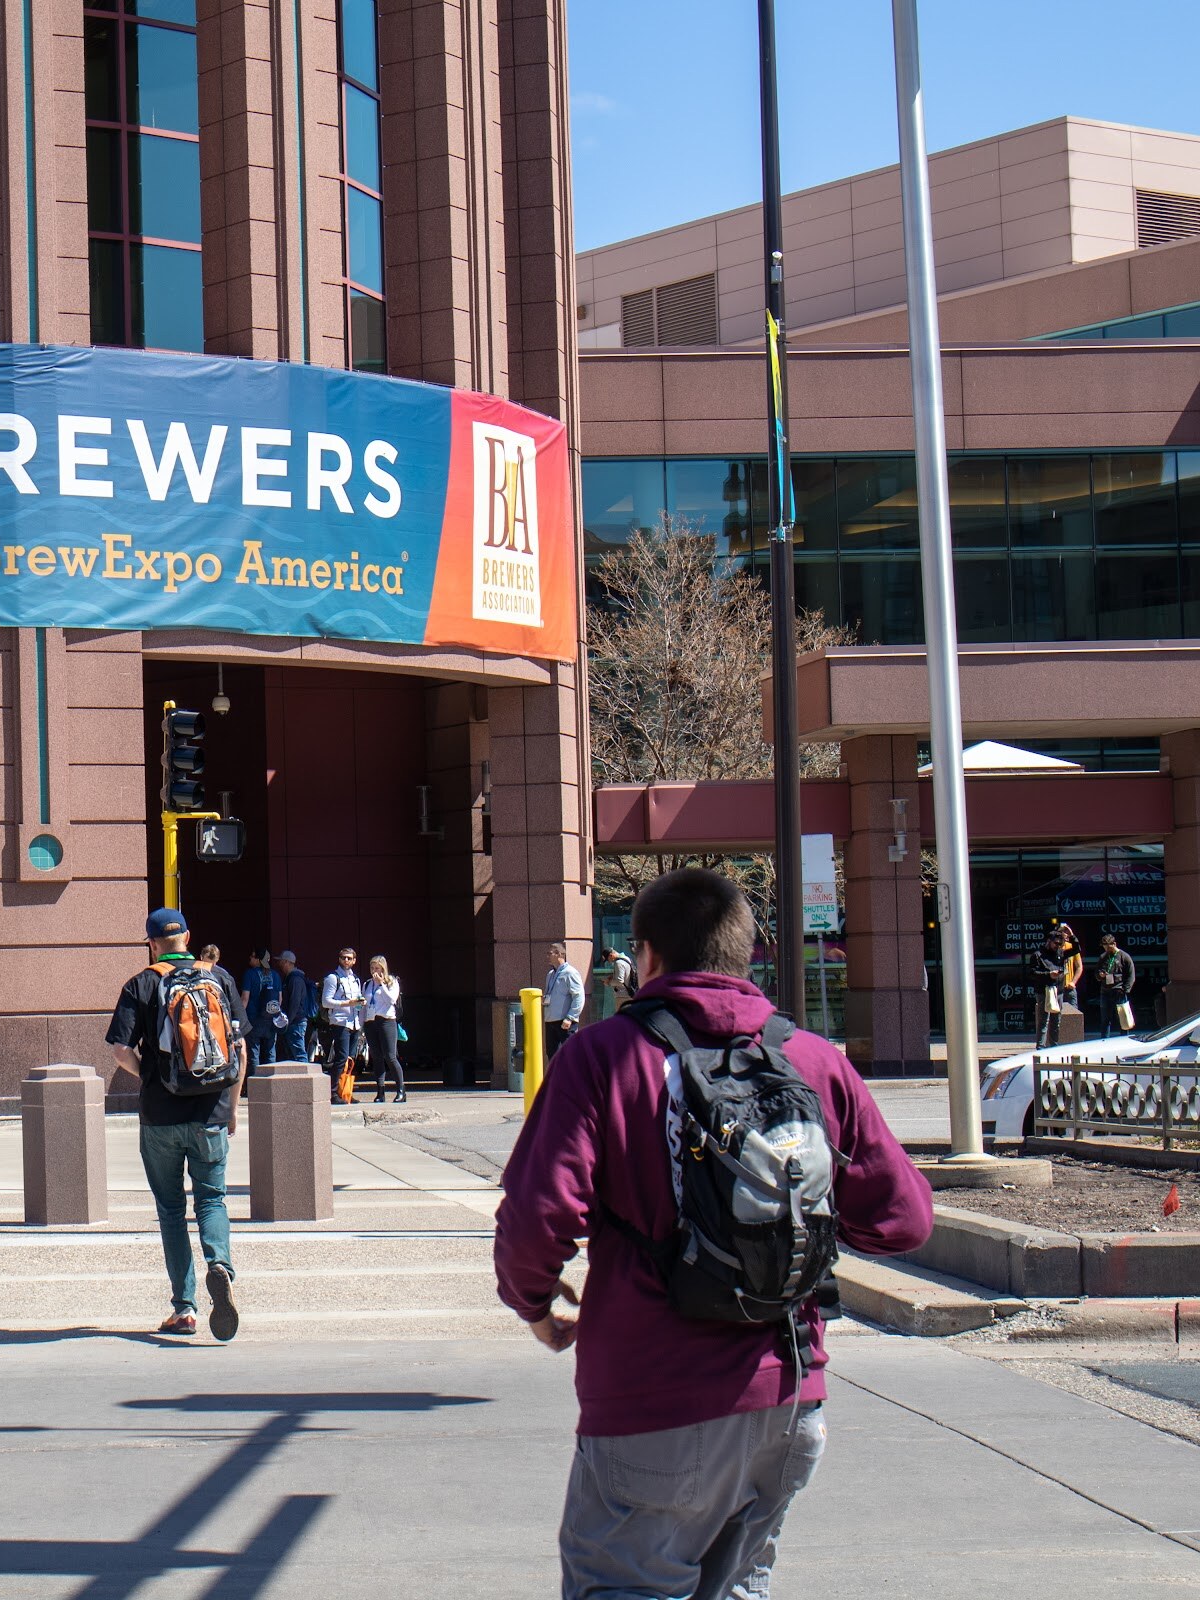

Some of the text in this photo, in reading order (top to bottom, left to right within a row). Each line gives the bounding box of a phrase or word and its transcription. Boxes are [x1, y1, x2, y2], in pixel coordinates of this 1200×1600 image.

[482, 557, 535, 593] BREWERS
[481, 590, 535, 616] ASSOCIATION
[811, 884, 823, 892] NO
[803, 893, 833, 902] PARKING
[803, 905, 835, 913] SHUTTLES
[1126, 905, 1161, 913] TENTS
[811, 913, 828, 921] ONLY
